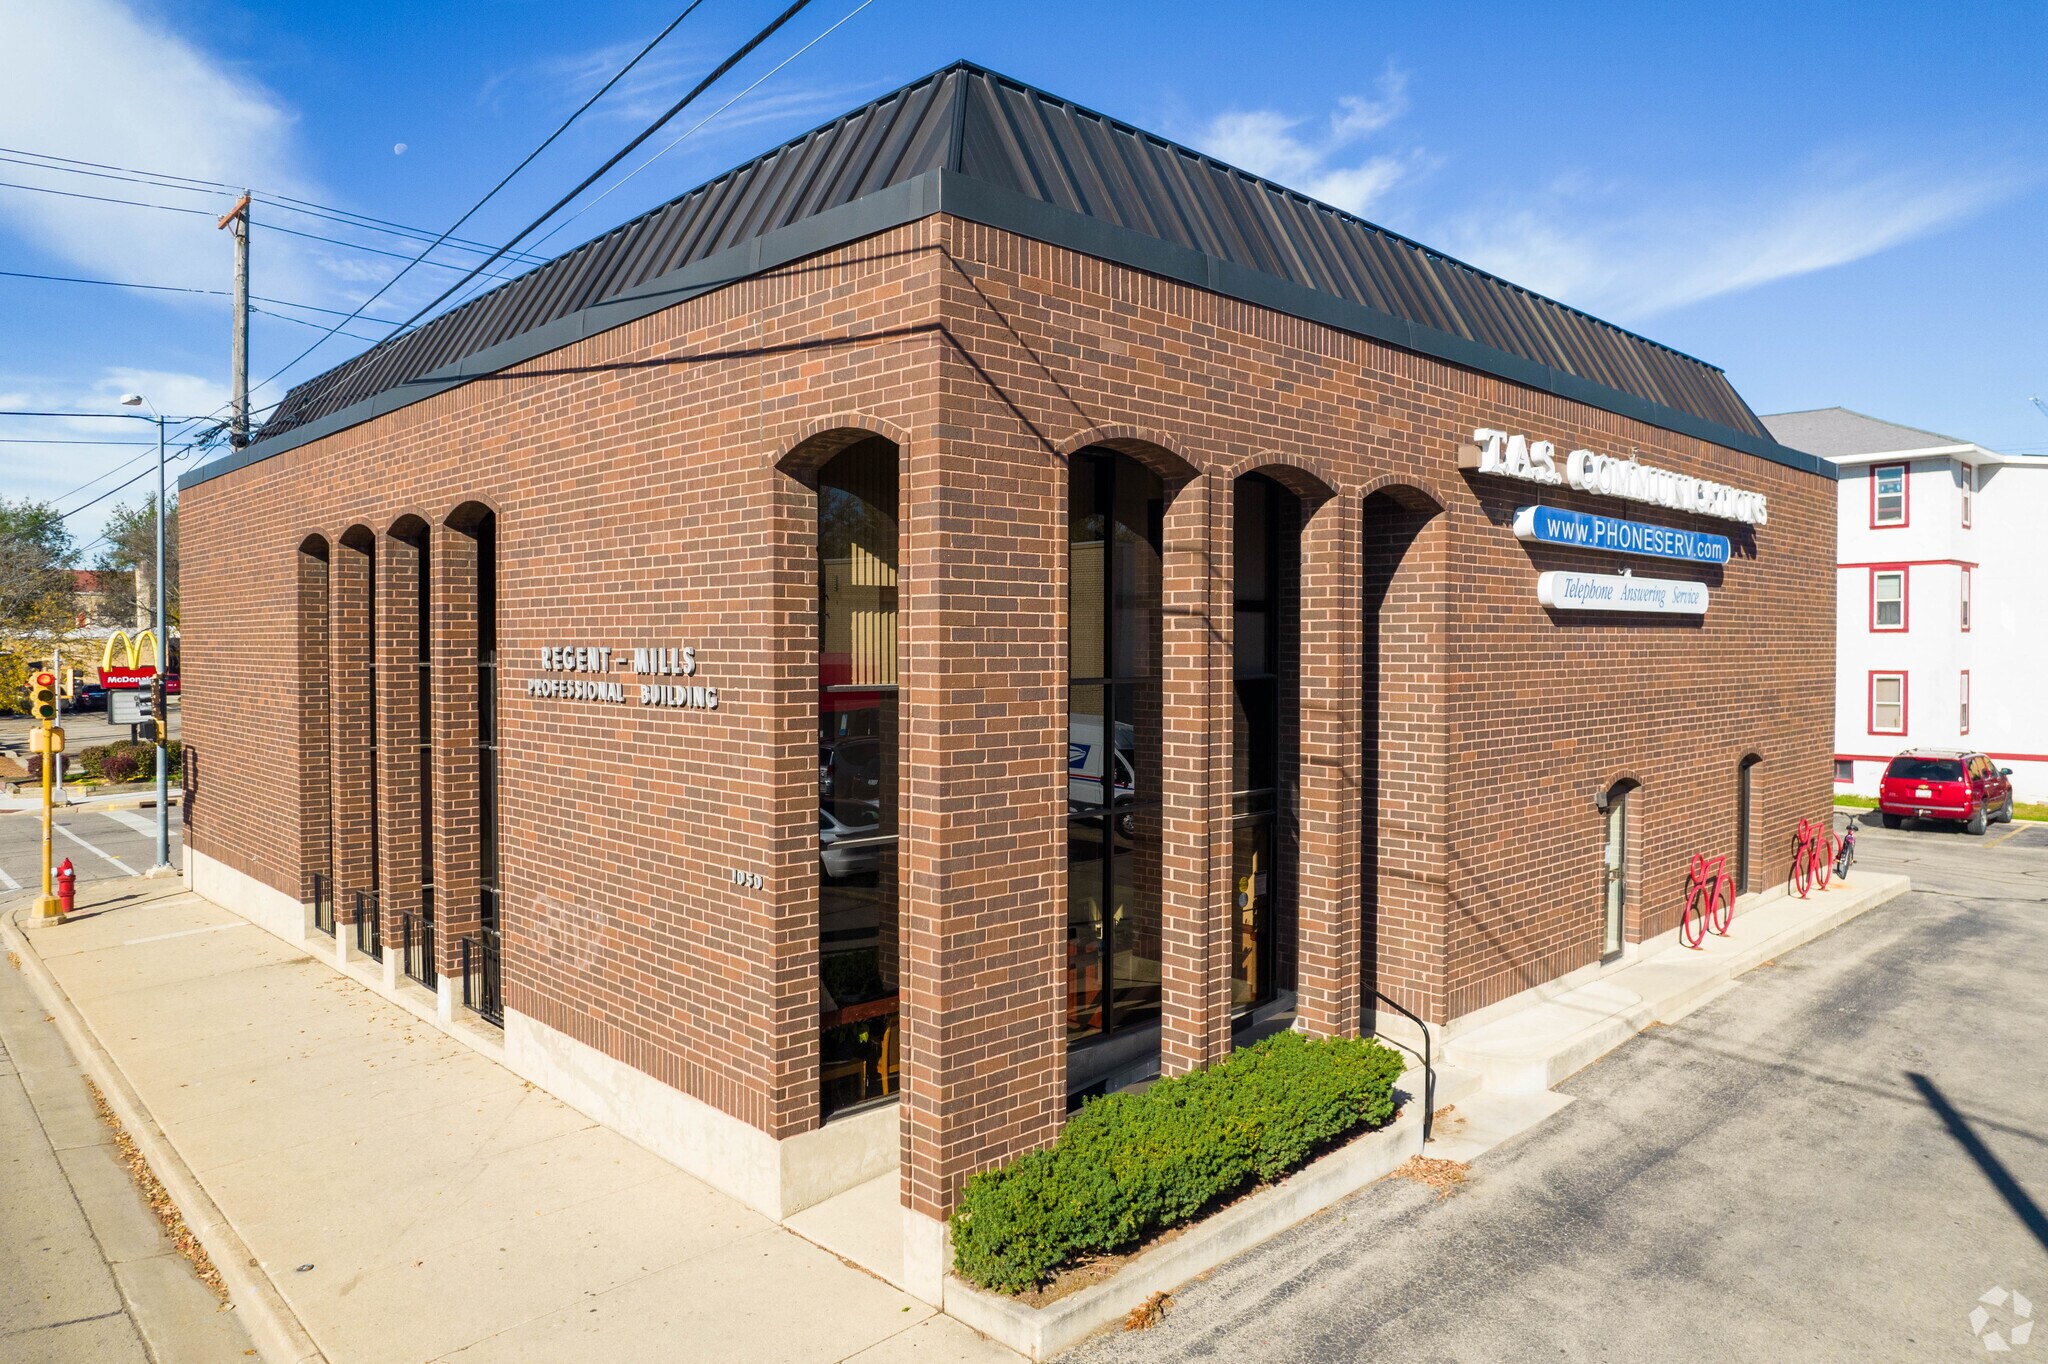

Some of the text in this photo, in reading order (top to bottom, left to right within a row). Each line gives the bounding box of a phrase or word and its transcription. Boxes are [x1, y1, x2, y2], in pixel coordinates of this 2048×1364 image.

[1566, 448, 1767, 525] COMMUNICATIONS
[1547, 518, 1722, 560] www.PHONESERV.com
[1564, 577, 1699, 608] Telephone Answering Service
[528, 678, 718, 709] PROFESSIONAL BUILDING
[732, 868, 763, 890] 1050
